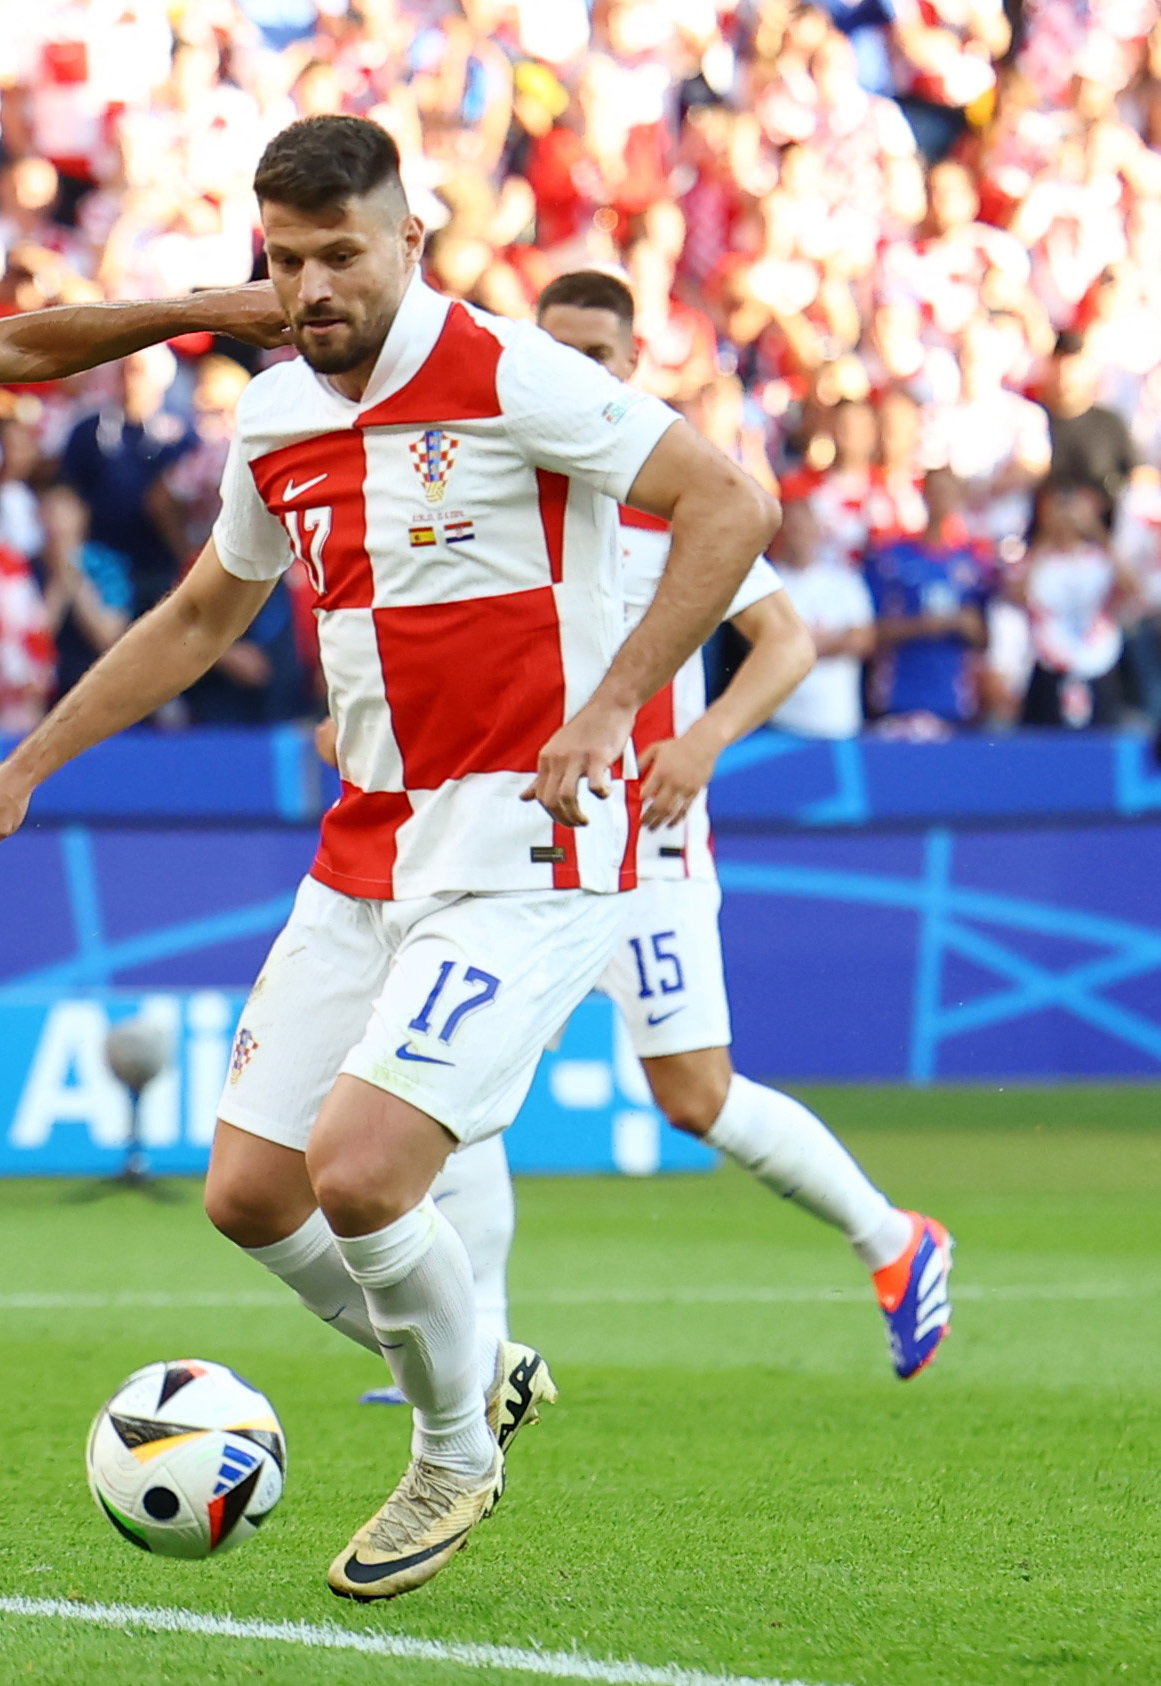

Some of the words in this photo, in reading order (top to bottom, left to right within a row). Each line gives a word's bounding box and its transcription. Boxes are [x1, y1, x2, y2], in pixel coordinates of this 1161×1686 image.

[284, 506, 333, 596] 17
[407, 960, 502, 1046] 17
[628, 930, 686, 999] 15
